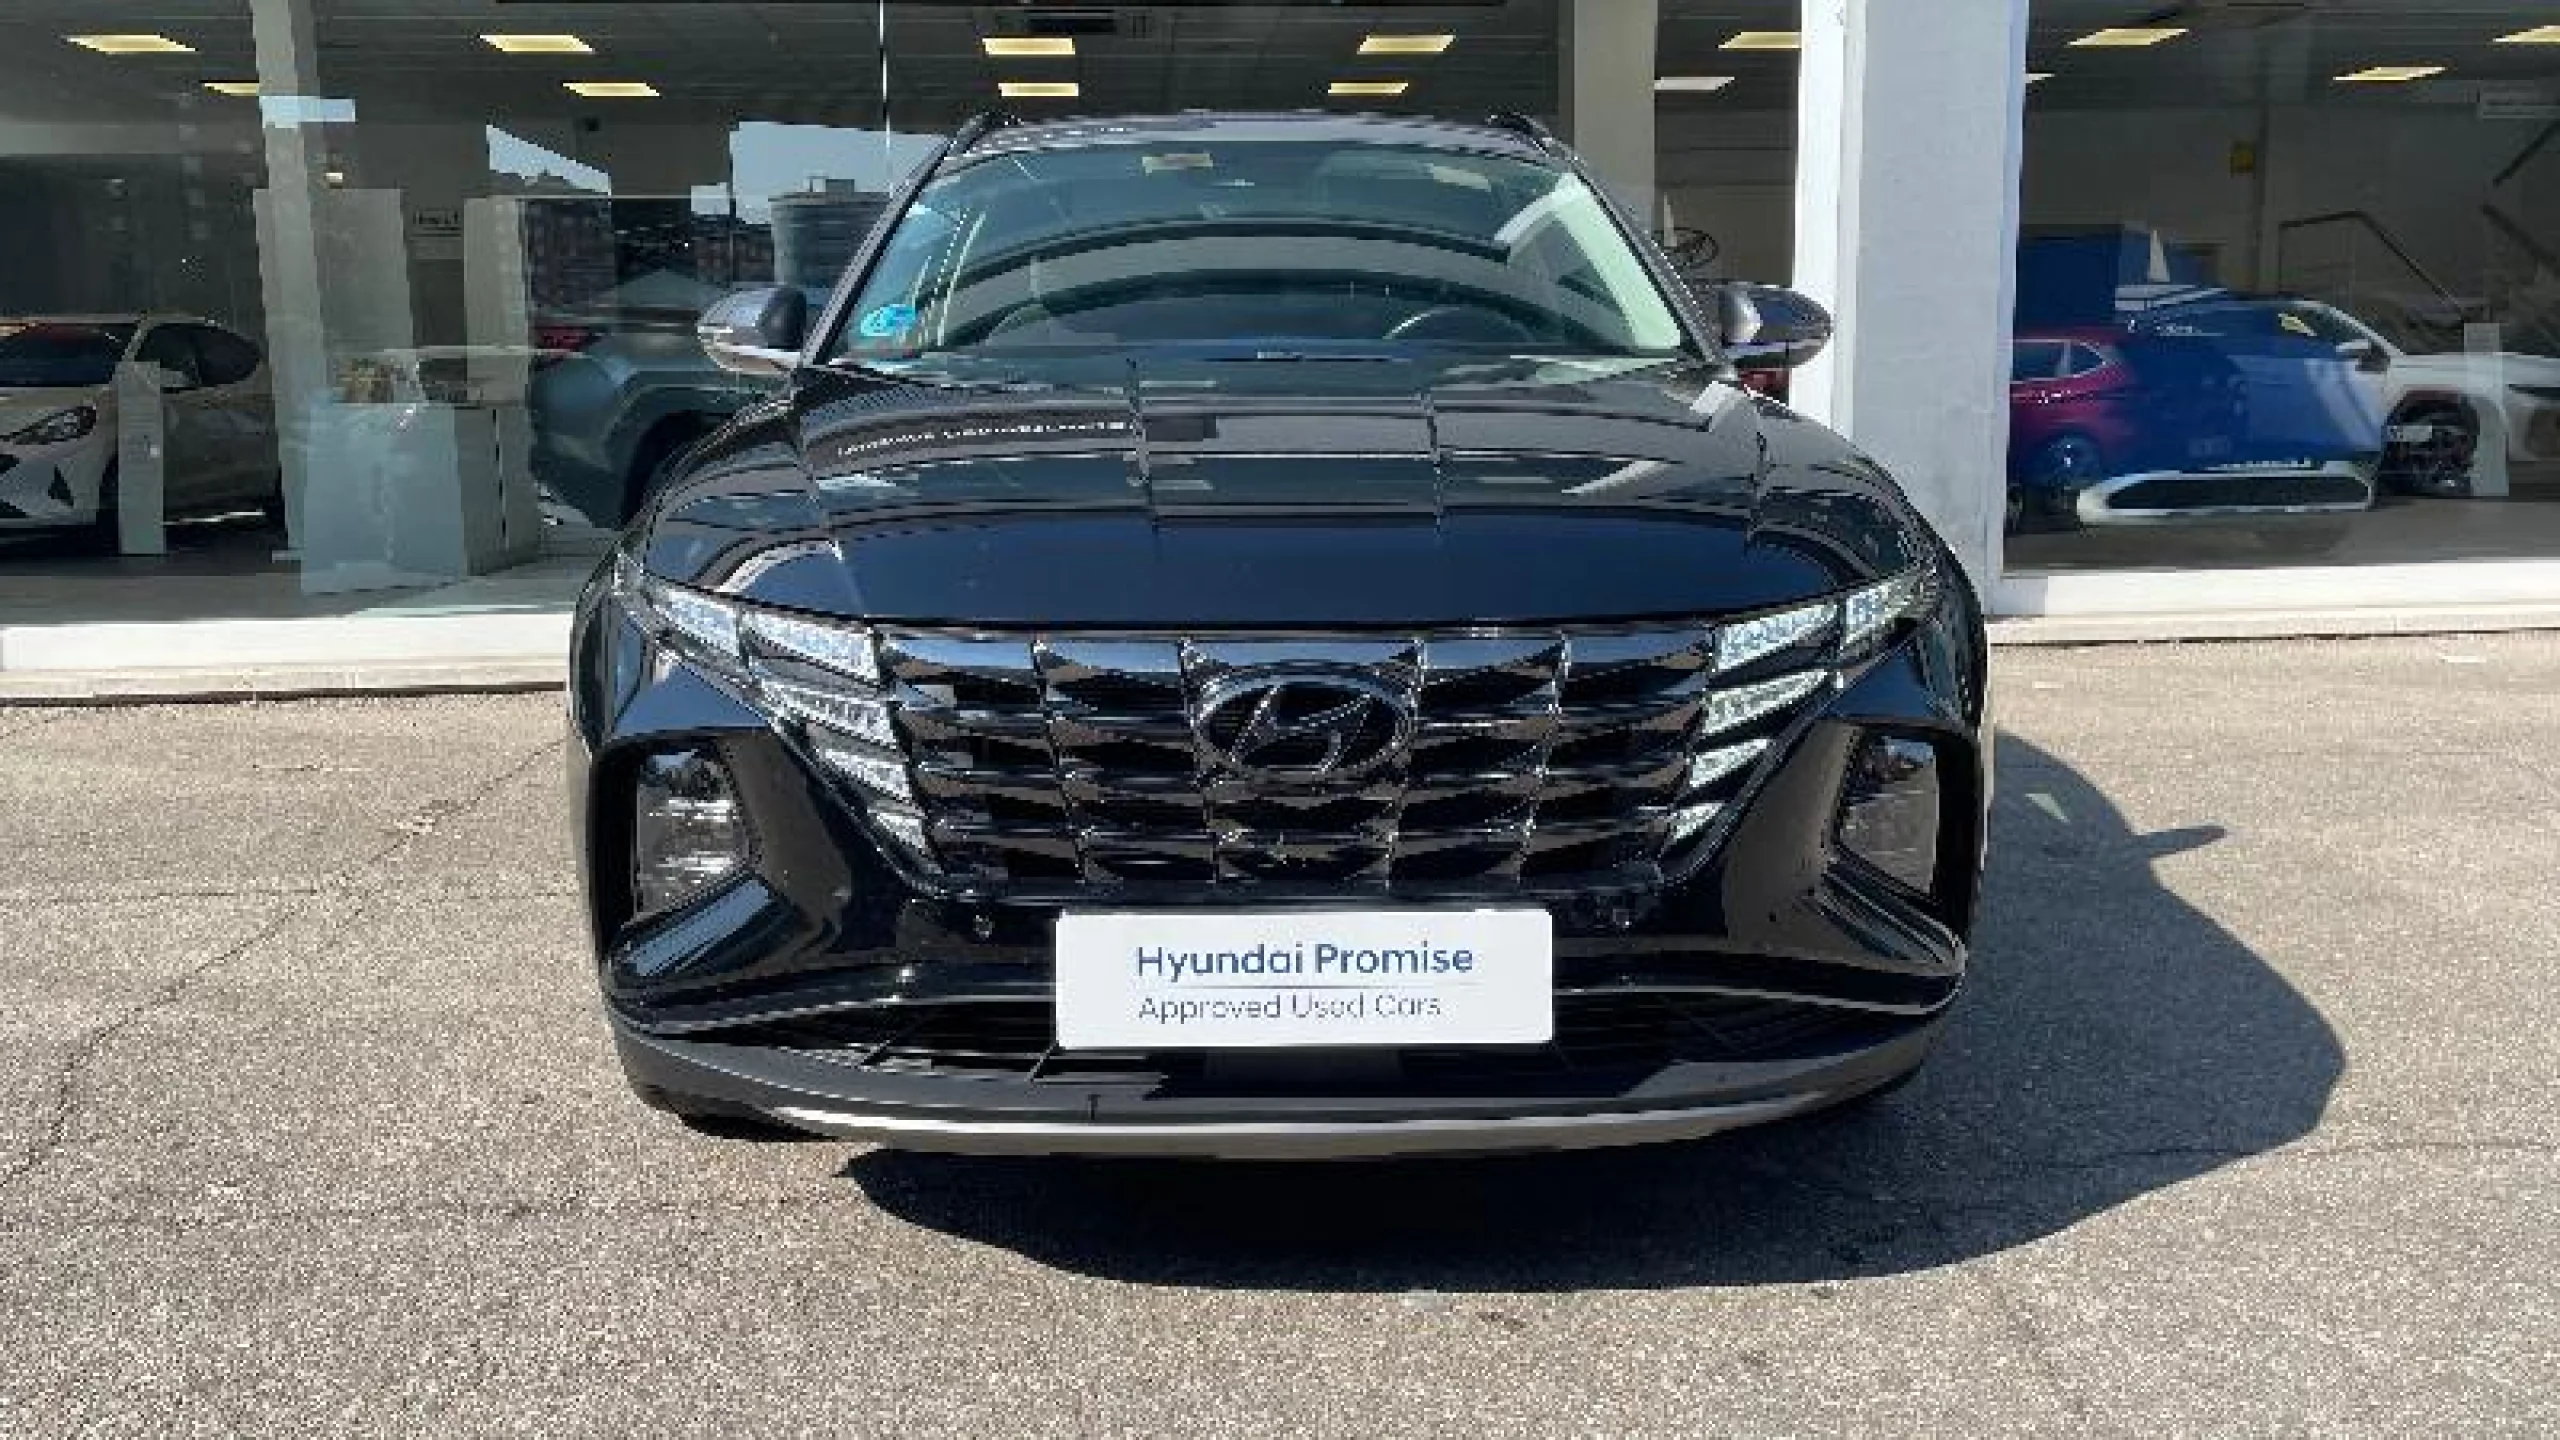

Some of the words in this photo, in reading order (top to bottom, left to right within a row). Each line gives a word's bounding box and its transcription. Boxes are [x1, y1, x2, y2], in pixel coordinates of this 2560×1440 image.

[1137, 942, 1303, 982] Hyundai
[1315, 941, 1474, 974] Promise
[1138, 993, 1281, 1025] Approved
[1292, 993, 1364, 1019] Used
[1375, 994, 1442, 1019] Cars
